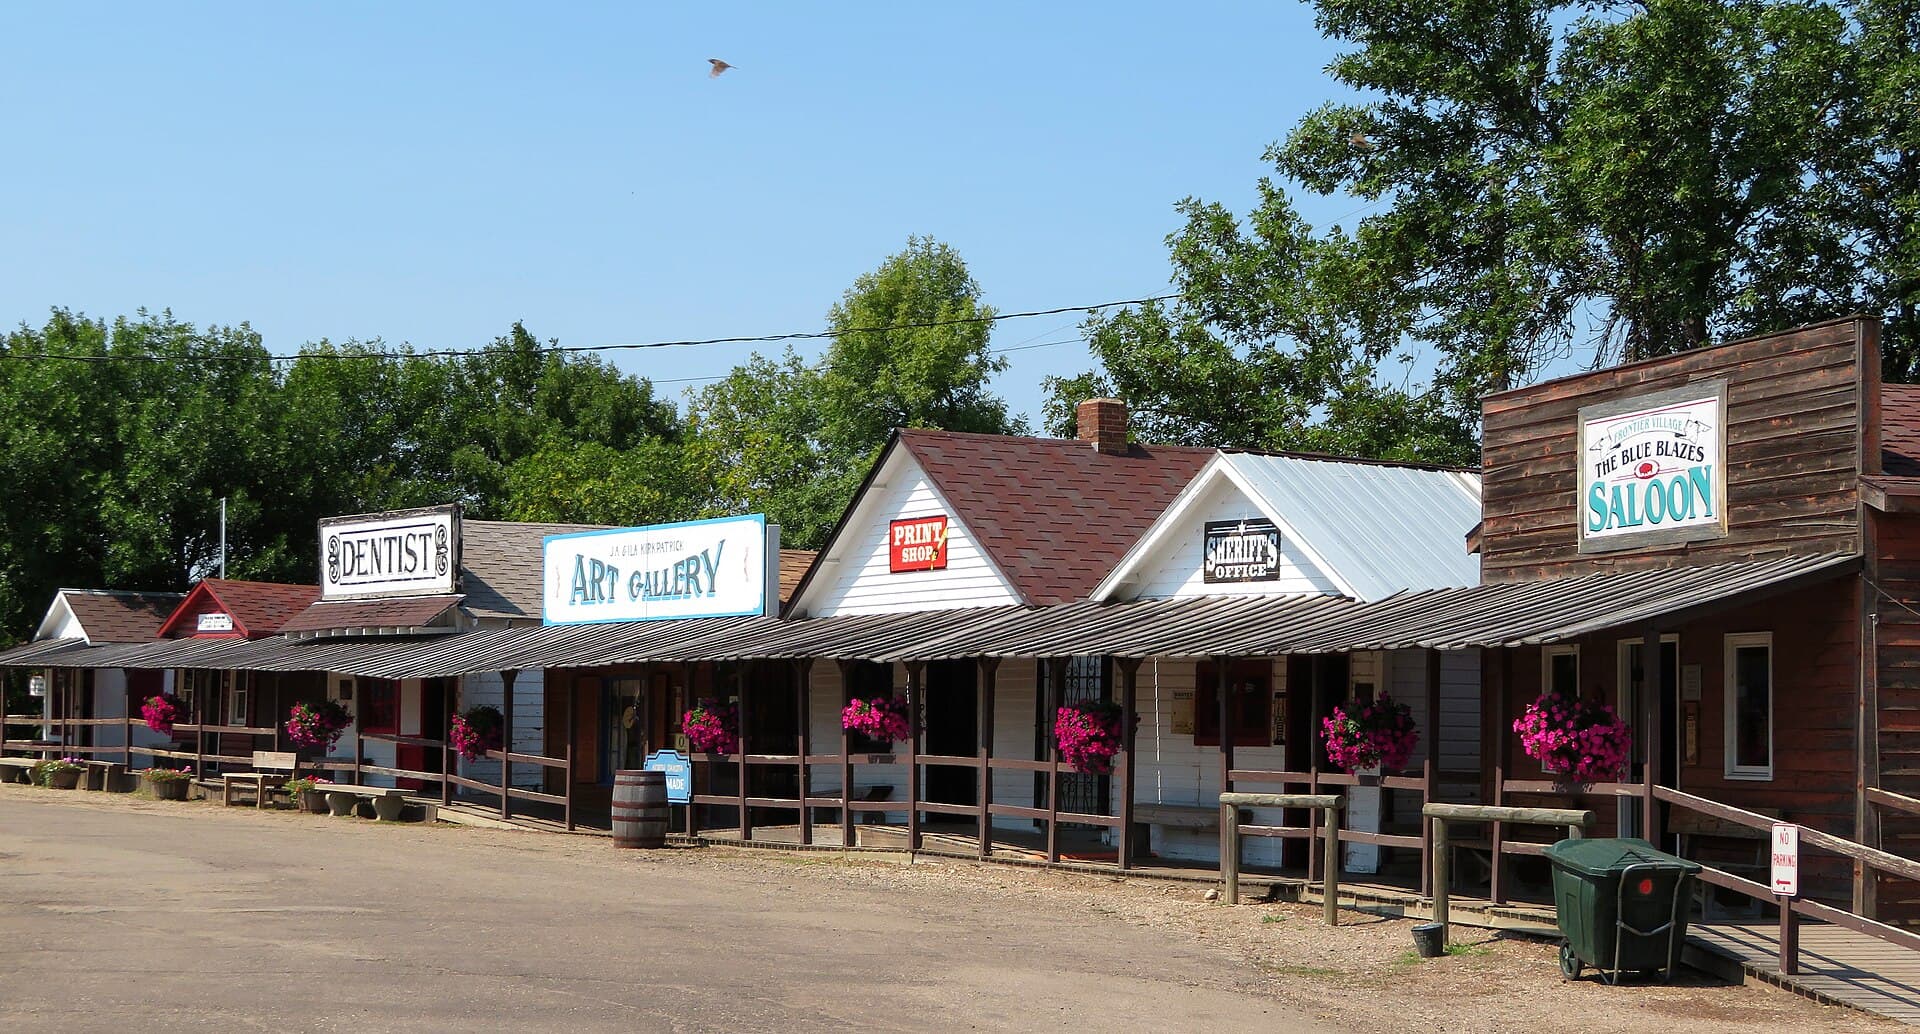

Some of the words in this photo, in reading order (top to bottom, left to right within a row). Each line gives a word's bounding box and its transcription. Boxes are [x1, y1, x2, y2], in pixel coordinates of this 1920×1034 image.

[1614, 417, 1650, 443] FRONTIER
[1651, 416, 1683, 431] VILLAGE
[1595, 455, 1618, 478] THE
[1621, 442, 1651, 466] BLUE
[1656, 440, 1705, 462] BLAZES
[1588, 464, 1713, 532] SALOON
[893, 521, 942, 546] PRINT
[342, 533, 433, 577] DENTIST
[902, 545, 934, 563] SHOP
[1206, 532, 1278, 572] SHERIFF'S
[570, 554, 619, 604] ART
[629, 538, 726, 601] GALLERY
[1215, 563, 1267, 579] OFFICE
[667, 778, 685, 791] MADE
[1780, 832, 1790, 845] NO
[1772, 853, 1796, 868] PARKING
